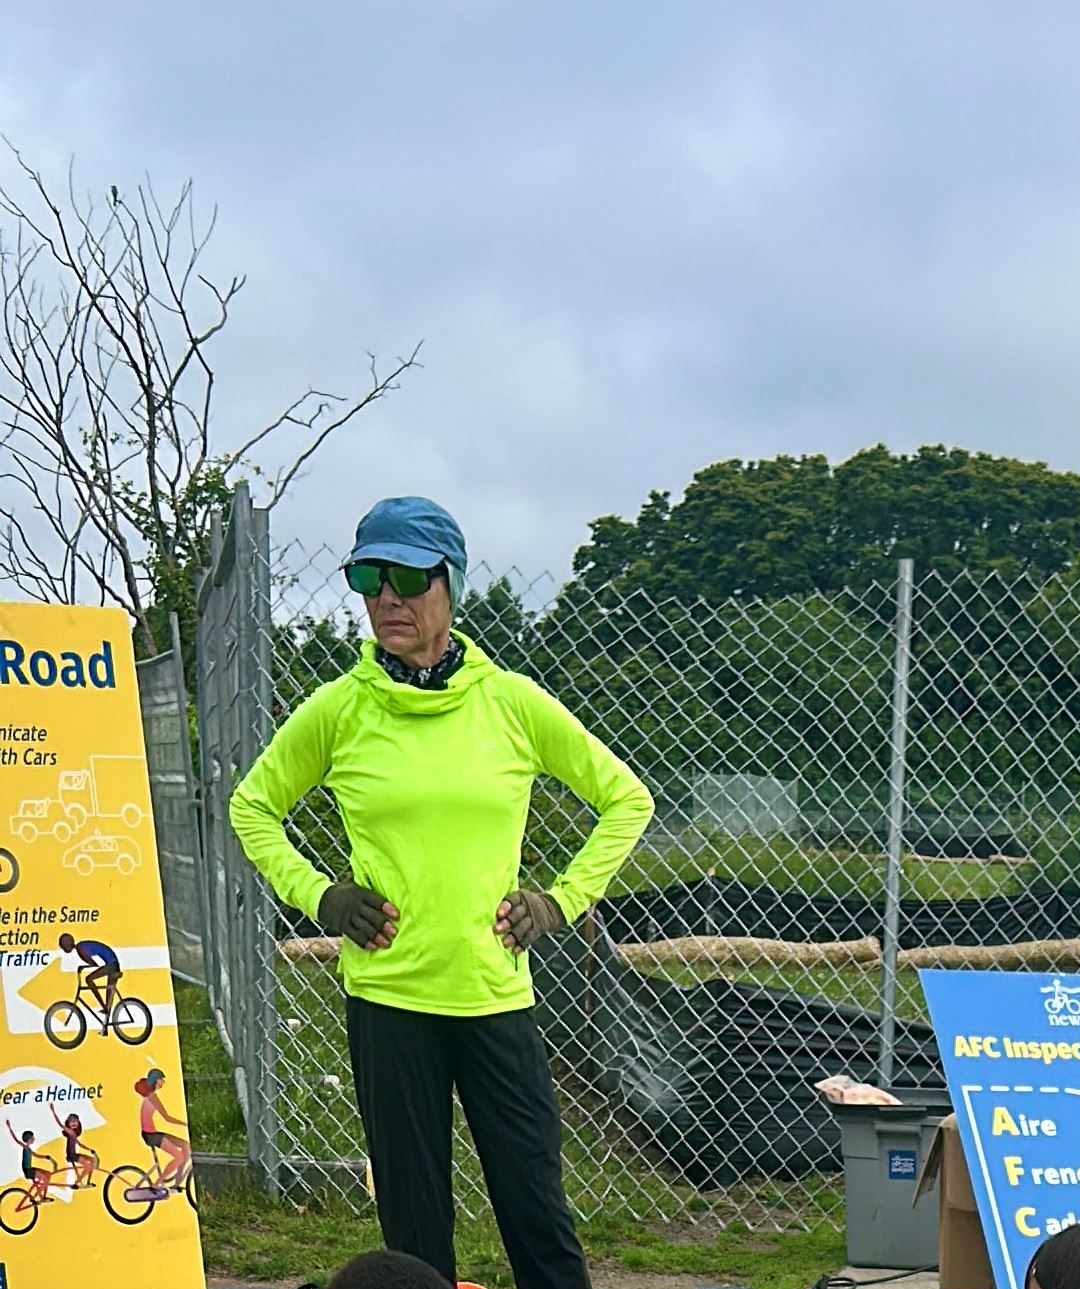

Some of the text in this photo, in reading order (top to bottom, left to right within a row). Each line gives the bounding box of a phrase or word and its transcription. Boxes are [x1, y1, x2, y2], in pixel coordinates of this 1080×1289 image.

[0, 639, 116, 689] Road
[23, 748, 57, 766] Cars
[14, 907, 29, 924] in
[32, 906, 57, 924] the
[60, 906, 100, 923] Same
[954, 1035, 1001, 1058] AFC
[0, 1083, 104, 1105] ear a Helmet
[992, 1106, 1057, 1136] Aire
